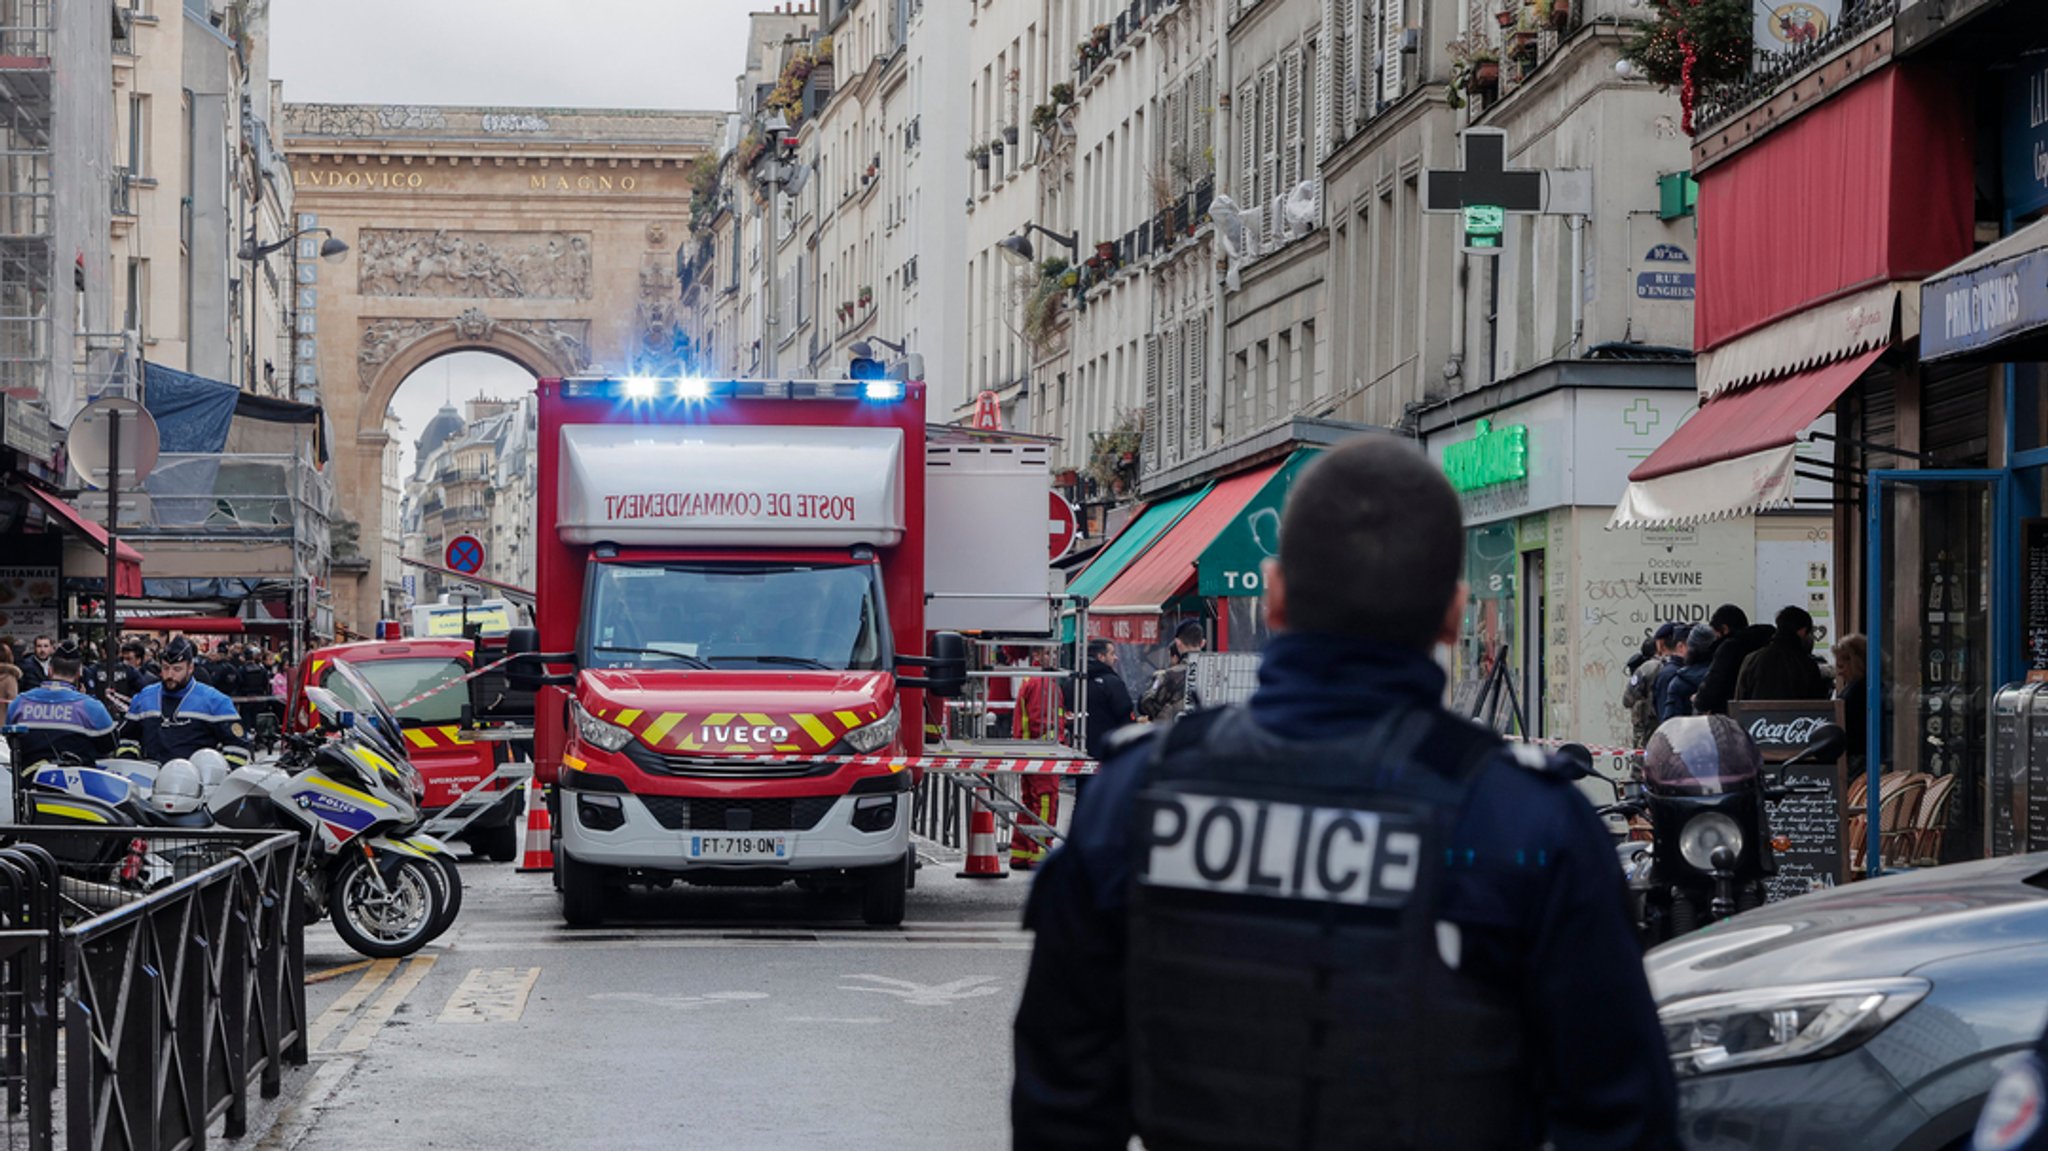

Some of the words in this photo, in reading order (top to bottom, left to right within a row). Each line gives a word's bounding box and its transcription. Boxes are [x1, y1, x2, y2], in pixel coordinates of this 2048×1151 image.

[294, 171, 423, 188] LVDOVICO
[530, 176, 636, 191] MAGNO
[1655, 273, 1681, 284] RUE
[303, 215, 316, 382] PASSAGE
[1648, 558, 1692, 569] Docteur
[1223, 571, 1268, 589] TO
[1638, 572, 1648, 586] J.
[1653, 572, 1703, 585] LEVINE
[1630, 610, 1649, 623] du
[1653, 604, 1710, 623] LUNDI
[1621, 636, 1640, 647] au
[22, 703, 74, 720] POLICE
[702, 725, 788, 743] IVECO
[318, 796, 357, 814] POLICE
[1146, 798, 1421, 903] POLICE
